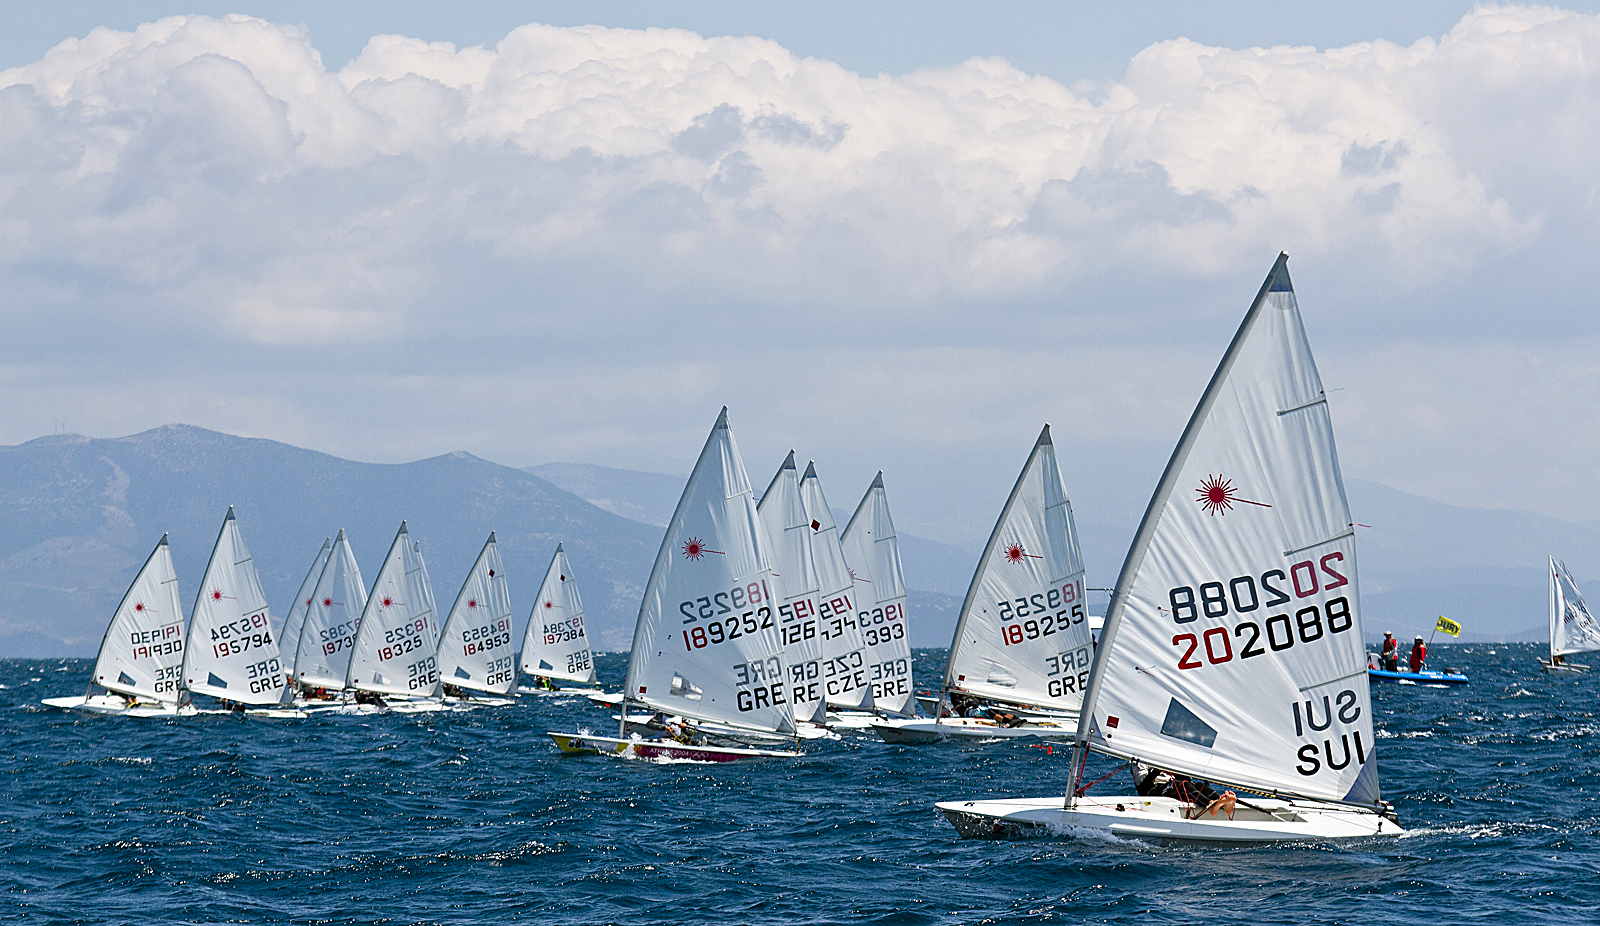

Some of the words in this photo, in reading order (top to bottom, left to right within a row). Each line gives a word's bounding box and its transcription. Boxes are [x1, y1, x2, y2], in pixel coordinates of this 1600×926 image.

[543, 627, 585, 646] 197384
[682, 605, 775, 652] 189252
[866, 622, 904, 646] 393
[1001, 604, 1084, 646] 189255
[1172, 596, 1353, 671] 202088
[1437, 620, 1459, 633] JURY
[133, 639, 183, 660] 191930
[213, 631, 273, 659] 195794
[322, 633, 357, 656] 1973
[377, 634, 423, 662] 18325
[463, 632, 510, 656] 184953
[486, 670, 512, 686] GRE
[567, 659, 591, 674] GRE
[250, 674, 284, 694] GRE
[408, 669, 438, 690] GRE
[826, 670, 868, 696] CZE
[872, 678, 909, 698] GRE
[1048, 670, 1090, 698] GRE
[736, 682, 787, 712] GRE
[793, 682, 820, 705] RE
[1295, 731, 1366, 777] SUI
